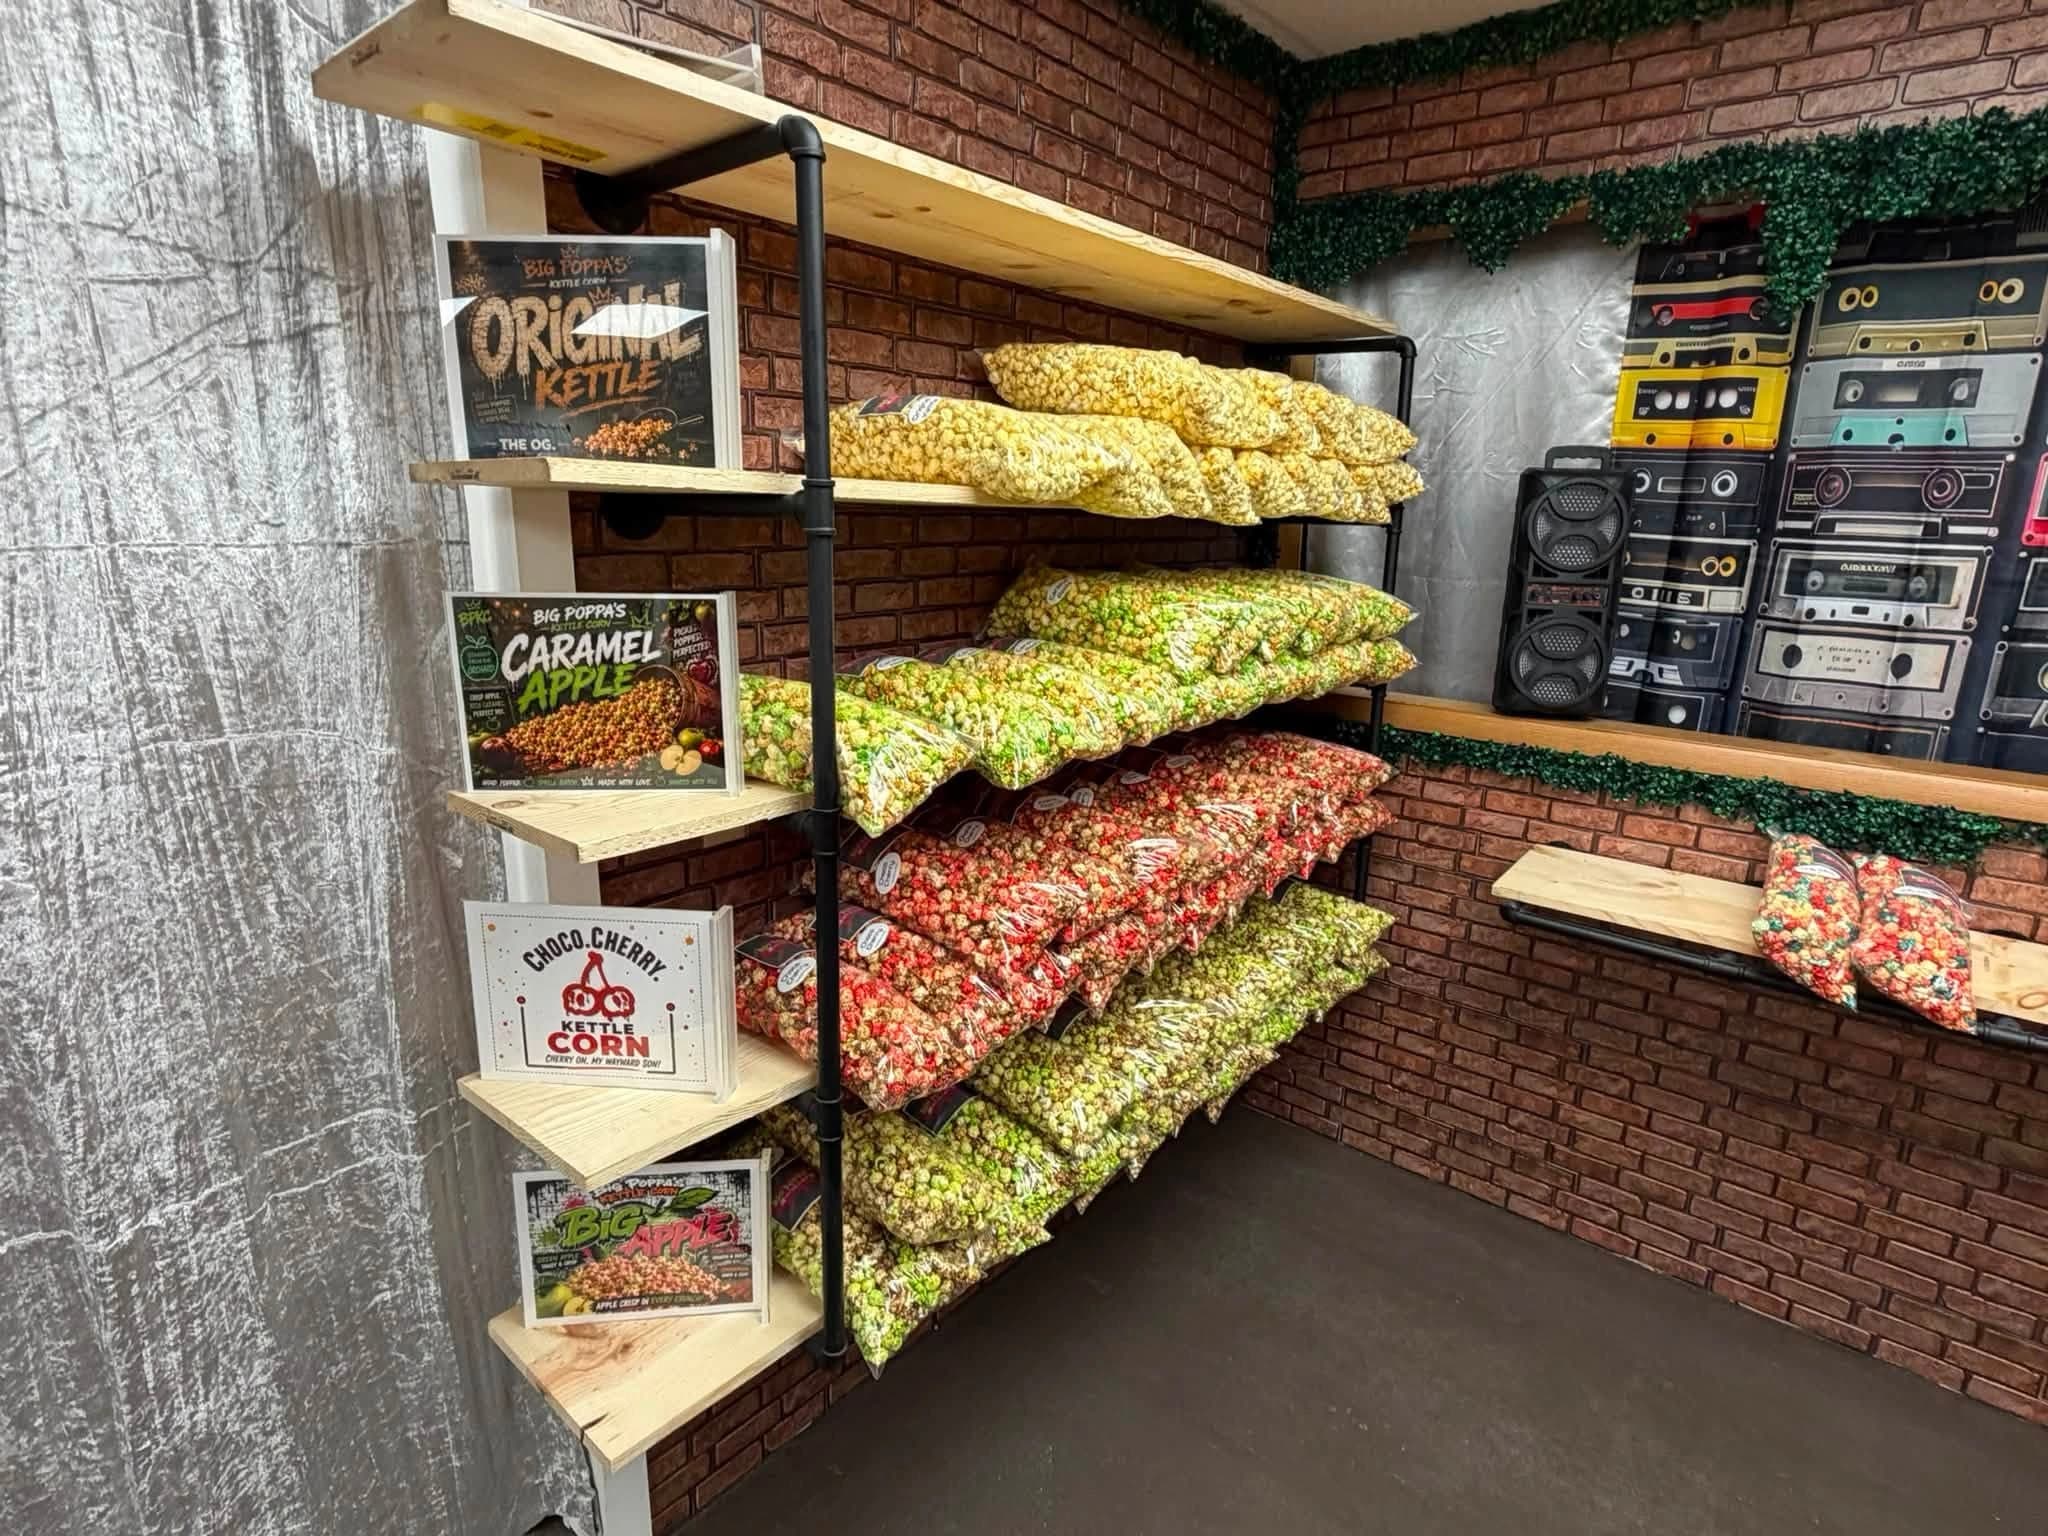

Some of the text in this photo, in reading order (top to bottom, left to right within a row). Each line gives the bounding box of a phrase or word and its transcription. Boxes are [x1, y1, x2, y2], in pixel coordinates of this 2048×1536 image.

[523, 256, 628, 279] BIG POPPA'S
[549, 276, 607, 288] KETTLE CORN
[535, 359, 664, 410] KETTLE
[499, 438, 556, 451] THE OG.
[533, 601, 627, 626] BIG POPPA'S
[550, 618, 611, 632] KETTLE CORN
[501, 630, 663, 686] CARAMEL
[517, 662, 638, 713] APPLE
[561, 1019, 634, 1035] KETTLE
[547, 1032, 650, 1057] CORN
[545, 1054, 574, 1064] CHERRY
[591, 1056, 602, 1065] MY
[605, 1057, 640, 1067] WAYWARD
[642, 1058, 662, 1069] SON!
[617, 1211, 733, 1257] APPLE
